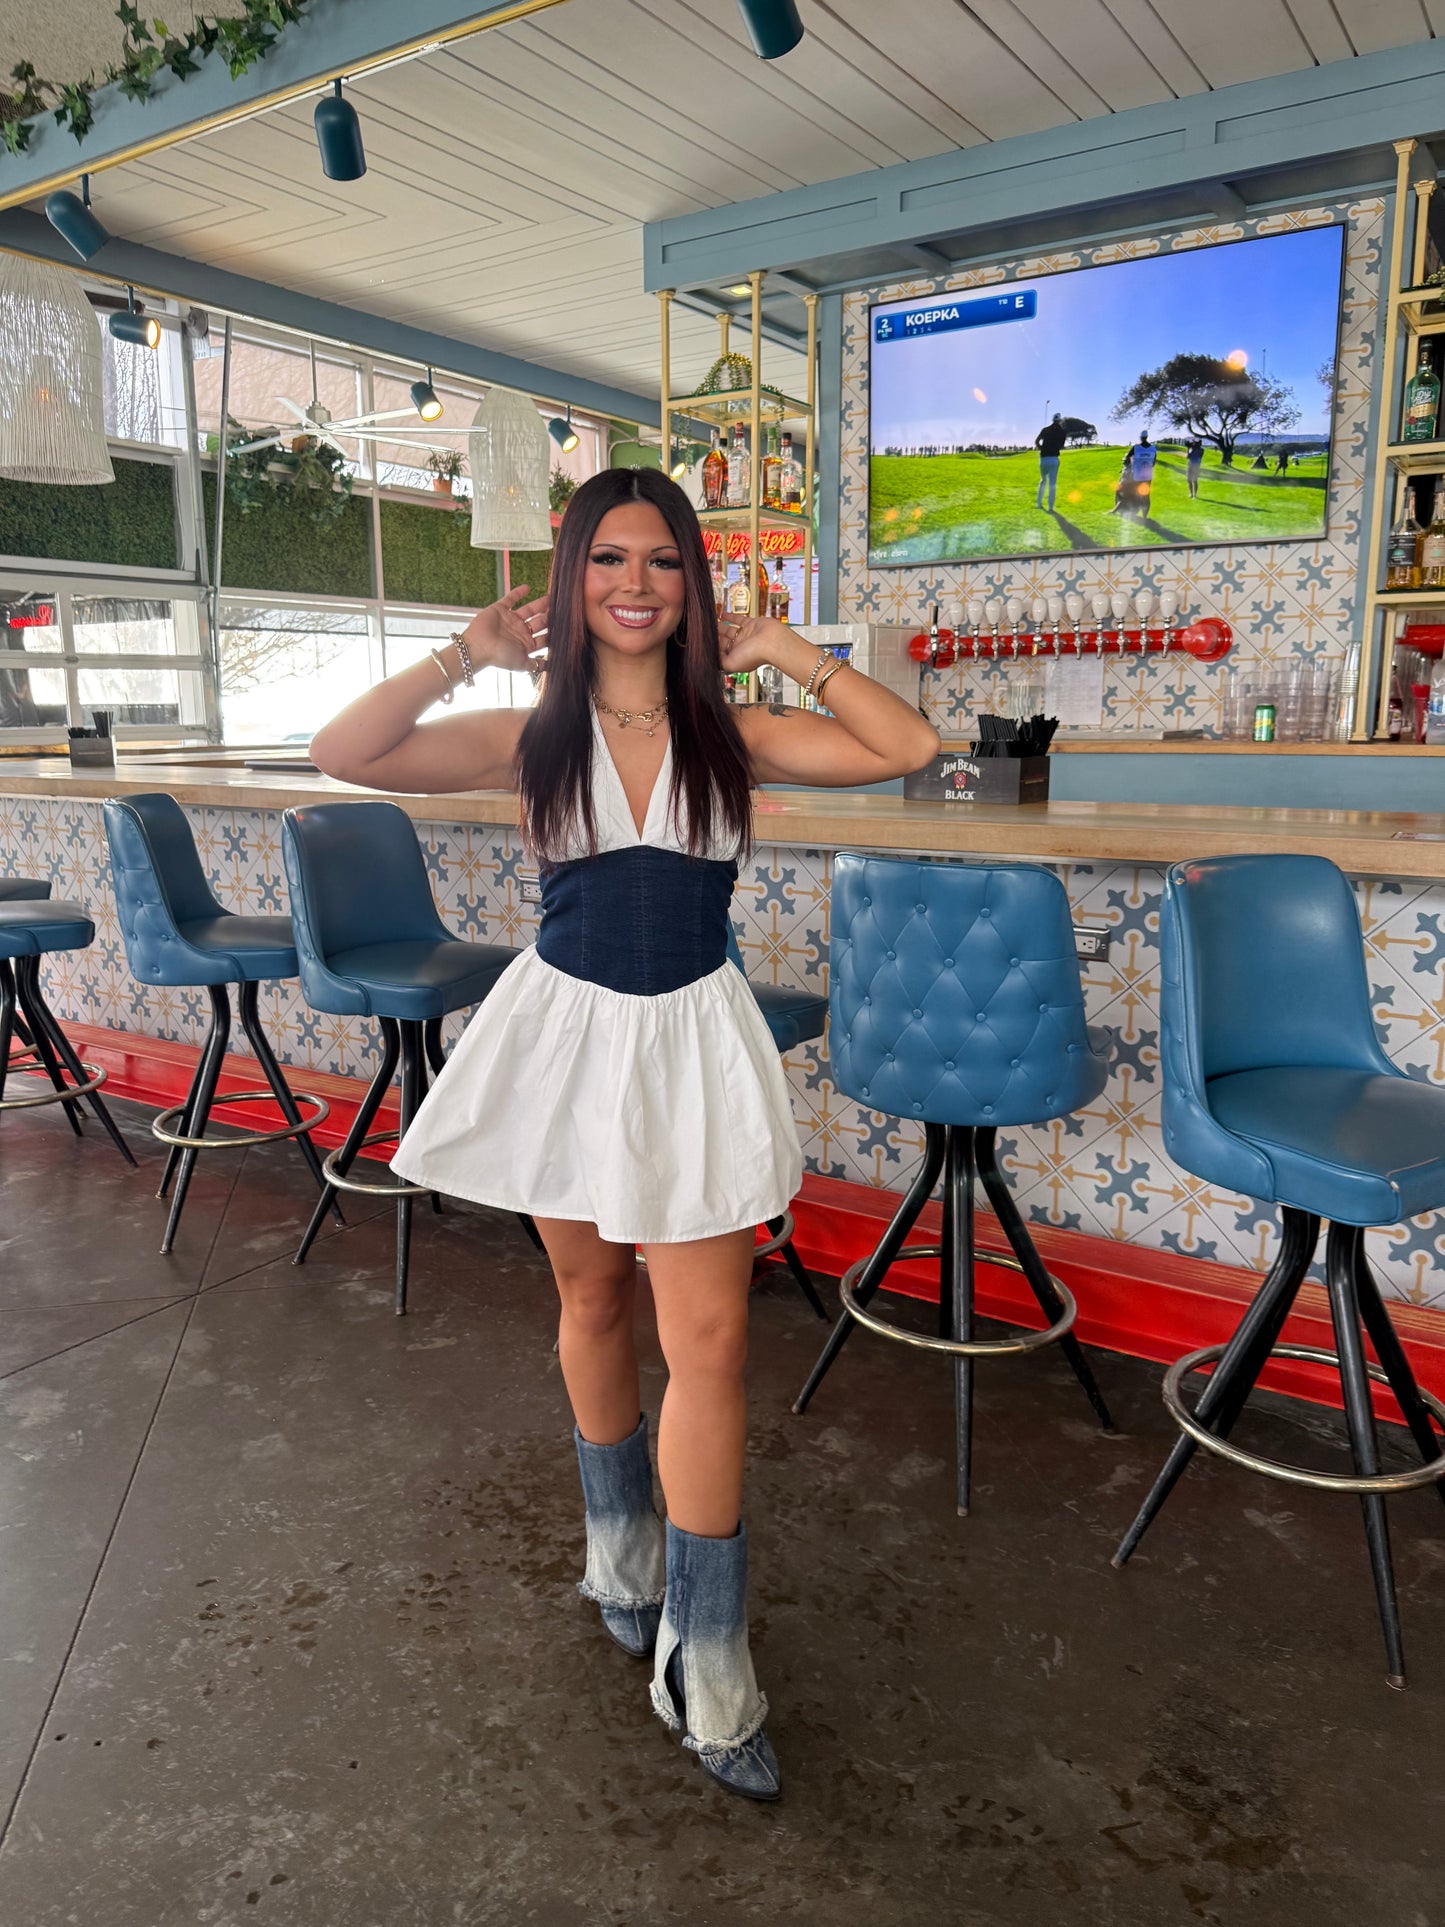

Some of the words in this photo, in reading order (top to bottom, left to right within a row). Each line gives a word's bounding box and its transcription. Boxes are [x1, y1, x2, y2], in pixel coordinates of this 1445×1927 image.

[1015, 295, 1025, 309] E
[881, 318, 889, 329] 2
[905, 307, 960, 327] KOEPKA
[940, 761, 957, 778] JIM
[957, 758, 980, 780] BEAM
[944, 789, 976, 801] BLACK
